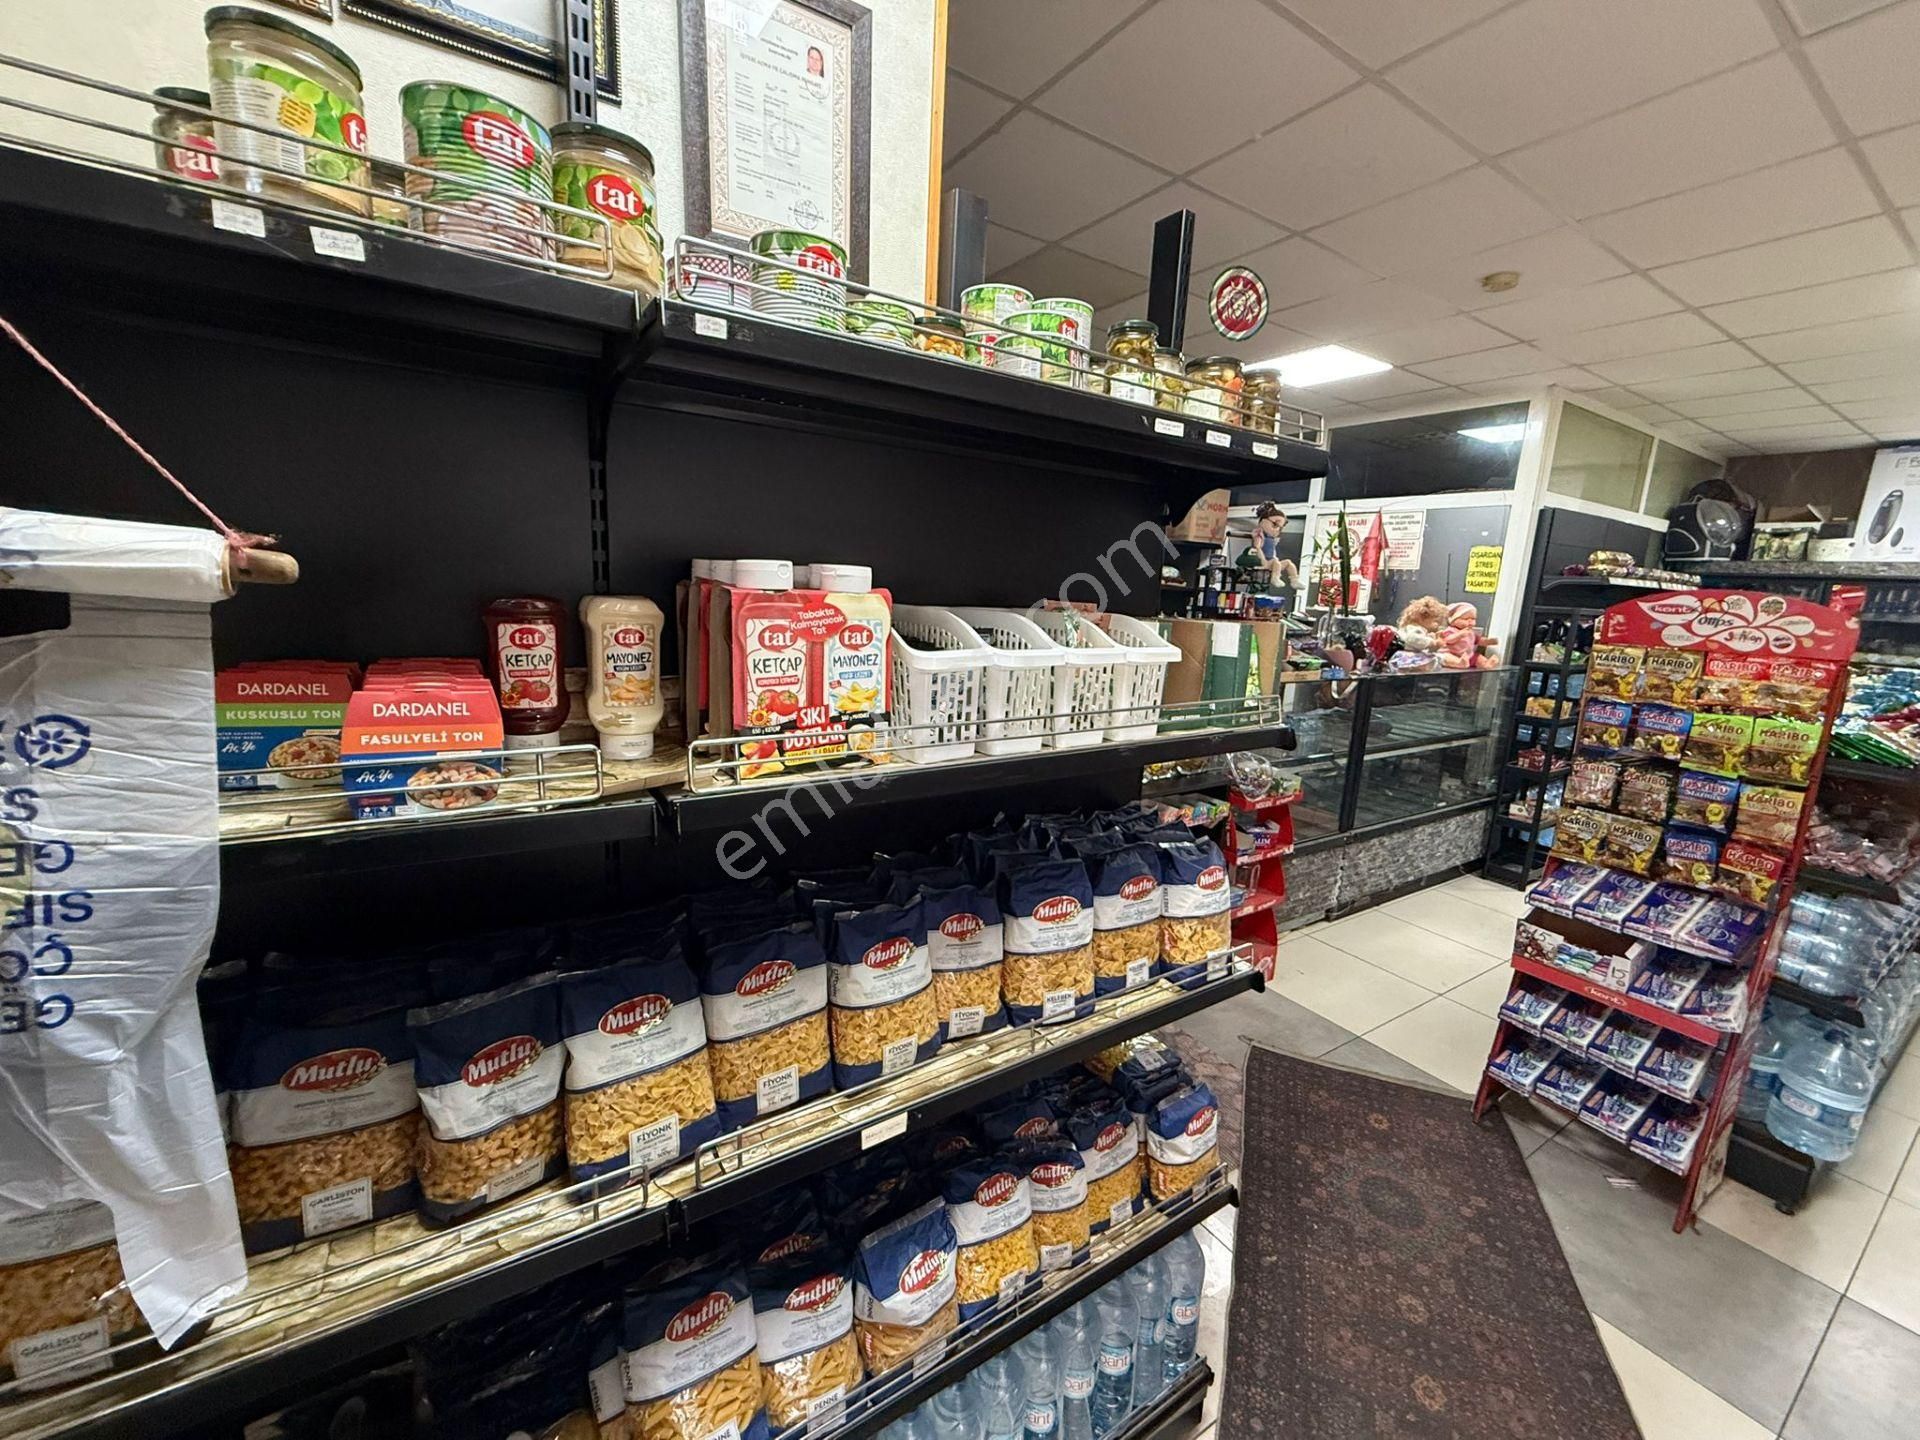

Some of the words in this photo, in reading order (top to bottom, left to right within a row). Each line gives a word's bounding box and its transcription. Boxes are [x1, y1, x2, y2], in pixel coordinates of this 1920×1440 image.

[593, 180, 640, 216] tat
[798, 608, 835, 619] Tabakta
[1655, 604, 1692, 613] kent
[790, 615, 845, 630] Kalmayacak
[811, 626, 827, 636] Tat
[514, 630, 541, 646] tat
[618, 630, 643, 645] tat
[763, 630, 795, 647] tat
[843, 628, 870, 646] tat
[505, 653, 552, 669] KETÇAP
[606, 652, 652, 664] MAYONEZ
[752, 656, 802, 674] KETÇAP
[833, 654, 879, 668] MAYONEZ
[1595, 654, 1635, 665] HARIBO
[1651, 657, 1693, 669] HARIBO
[1709, 661, 1760, 673] HARIBO
[238, 683, 329, 696] DARDANEL
[226, 711, 307, 720] KUSKUSLU
[312, 710, 341, 719] TON
[373, 702, 470, 717] DARDANEL
[800, 706, 826, 726] SIKI
[360, 730, 447, 746] FASULYELİ
[453, 732, 483, 742] TON
[1612, 824, 1652, 842] HARIBO
[1200, 869, 1224, 887] Mutlu
[1123, 878, 1156, 898] Mutlu
[1037, 901, 1076, 919] Mutlu
[943, 916, 979, 935] Mutlu
[867, 942, 908, 966] Mutlu
[740, 963, 789, 992] Mutlu
[605, 999, 661, 1032] Mutlu
[290, 1053, 374, 1087] Mutlu
[467, 1041, 532, 1081] Mutlu
[763, 1072, 792, 1088] FİYONK
[636, 1121, 672, 1143] FİYONK
[1031, 1164, 1072, 1179] Mutlu
[978, 1175, 1016, 1204] Mutlu
[903, 1250, 948, 1290] Mutlu
[789, 1275, 838, 1308] Mutlu
[670, 1296, 728, 1339] Mutlu
[814, 1392, 839, 1411] PENNE
